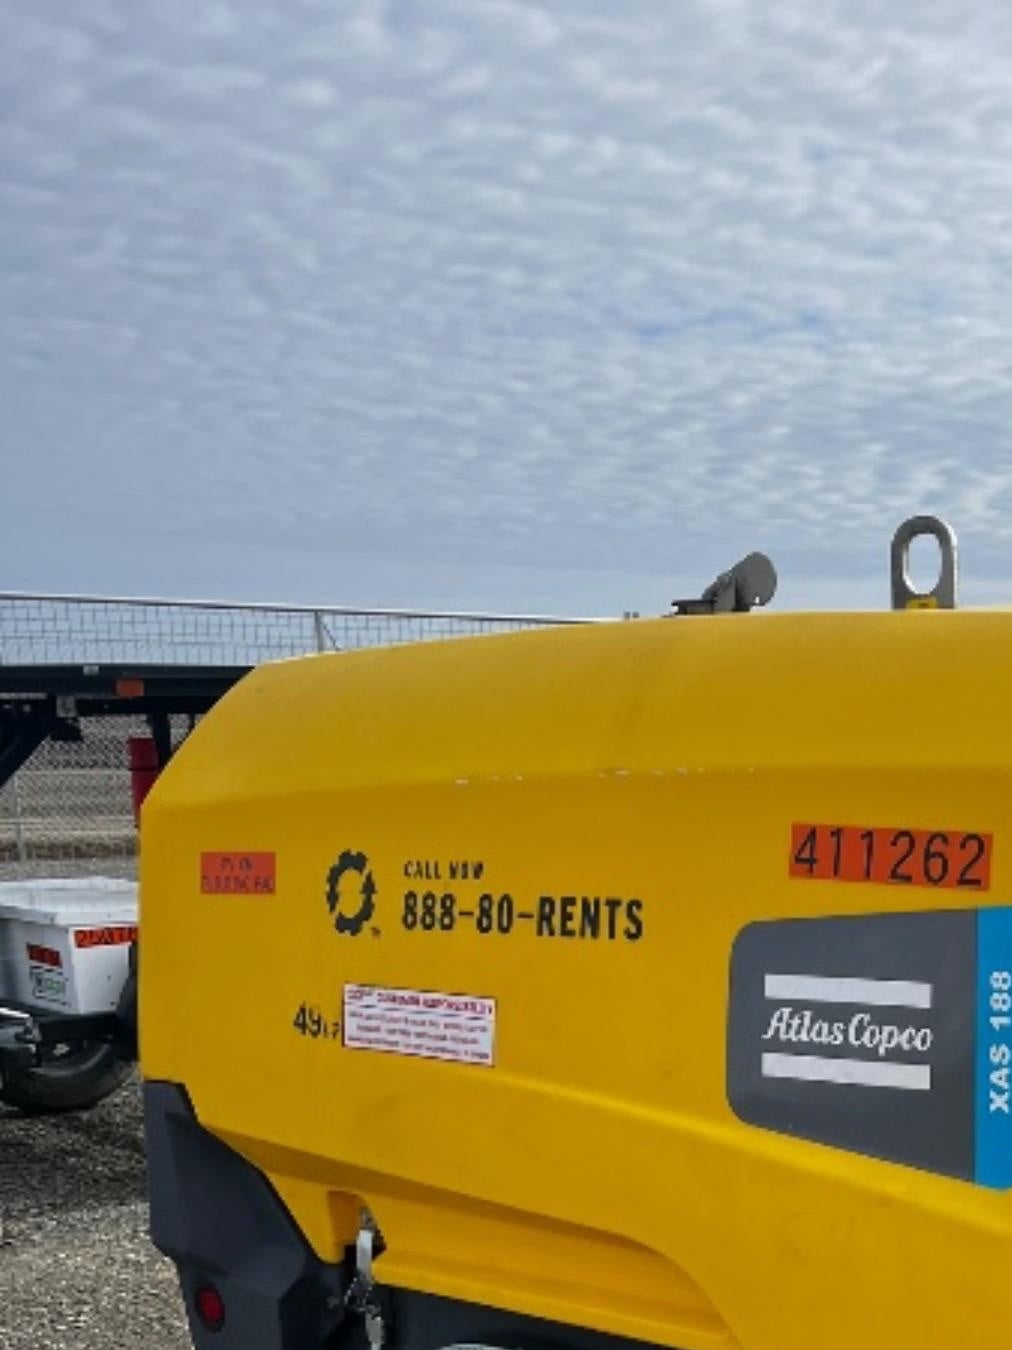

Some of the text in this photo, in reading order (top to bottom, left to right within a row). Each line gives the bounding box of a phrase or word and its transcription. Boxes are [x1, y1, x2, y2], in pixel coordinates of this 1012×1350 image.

[403, 860, 484, 880] CALL NOW
[793, 826, 986, 887] 411262
[402, 890, 644, 941] 888-80-RENTS
[762, 1006, 934, 1057] Atlas Copco
[989, 970, 1012, 1114] XAS 188
